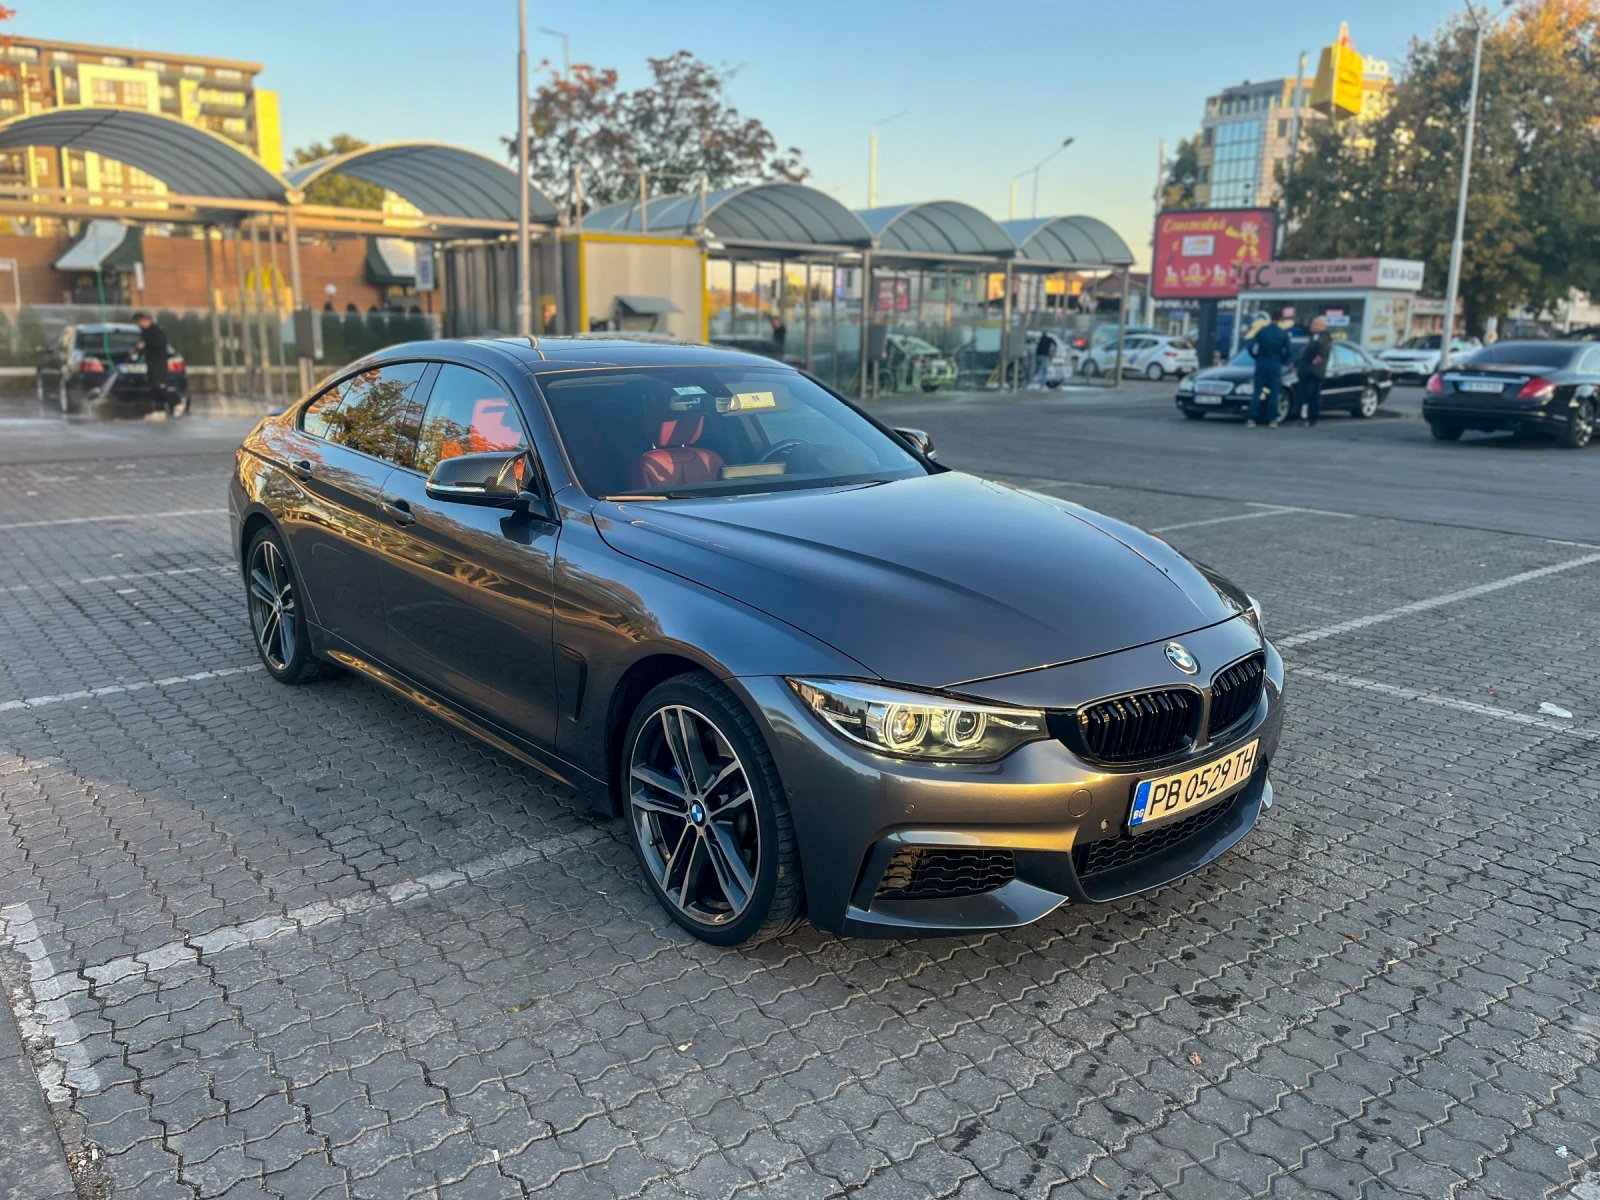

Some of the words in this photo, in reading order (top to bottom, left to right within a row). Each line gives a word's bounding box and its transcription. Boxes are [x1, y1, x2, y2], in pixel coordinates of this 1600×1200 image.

[1148, 779, 1182, 816] PB
[1185, 758, 1232, 803] 0529
[1233, 744, 1256, 780] TH
[1133, 808, 1145, 820] BG
